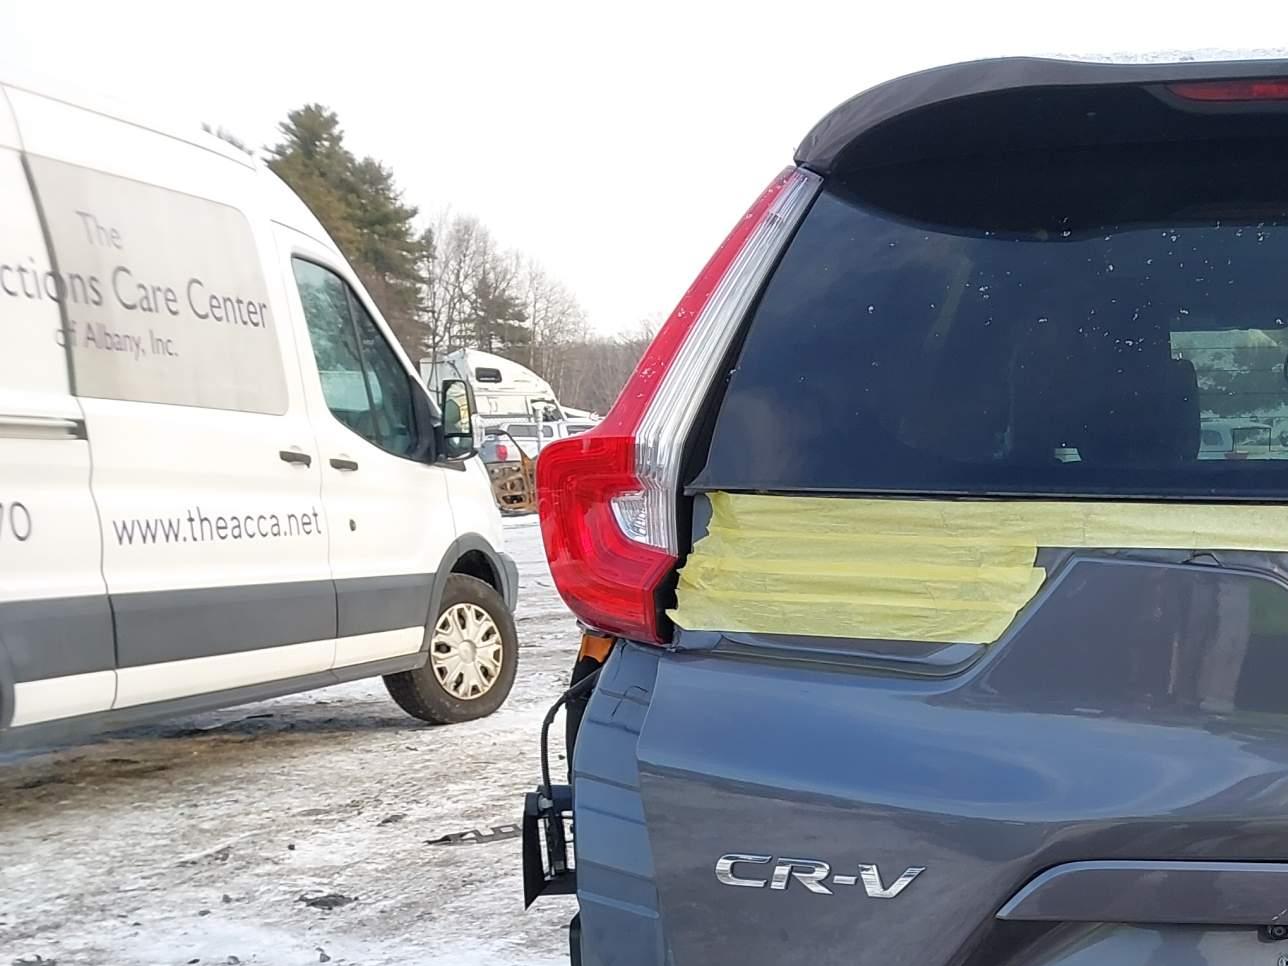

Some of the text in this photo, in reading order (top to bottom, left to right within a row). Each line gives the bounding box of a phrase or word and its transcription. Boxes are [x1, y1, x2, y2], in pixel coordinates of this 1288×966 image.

[75, 210, 122, 250] The
[0, 256, 267, 328] ctions Care Center
[148, 329, 178, 357] Inc.
[0, 501, 32, 542] 0
[112, 506, 322, 546] www.theacca.net
[715, 853, 926, 899] CR-V
